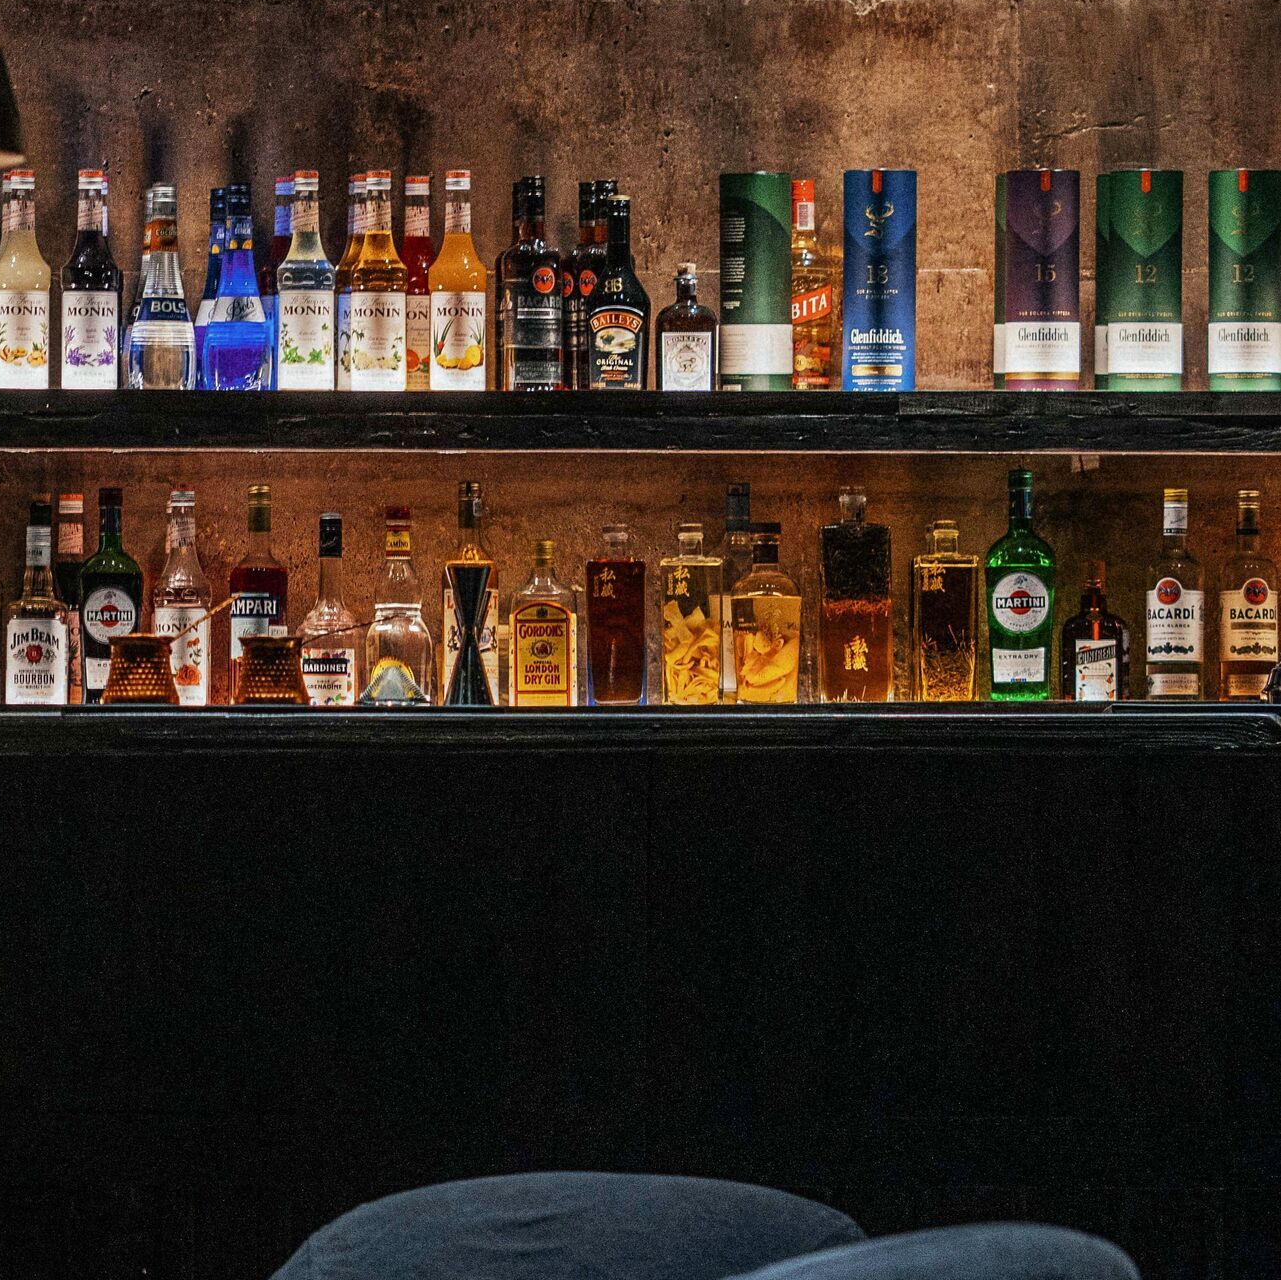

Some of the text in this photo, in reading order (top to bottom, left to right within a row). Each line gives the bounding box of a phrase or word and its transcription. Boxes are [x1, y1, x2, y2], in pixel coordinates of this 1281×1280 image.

[1033, 264, 1057, 282] 15
[1135, 264, 1158, 283] 12
[1232, 264, 1255, 283] 12
[0, 304, 46, 316] MONIN
[67, 304, 114, 317] MONIN
[150, 300, 186, 314] BOLS
[283, 304, 330, 316] MONIN
[353, 306, 400, 318] MONIN
[436, 305, 483, 317] MONIN
[592, 314, 638, 329] BAILEYS
[596, 358, 634, 366] ORIGINAL
[997, 597, 1045, 608] MARTINI
[88, 611, 132, 621] MARTINI
[10, 627, 60, 650] JIM BEAM
[303, 664, 347, 673] BARDINET
[524, 664, 560, 674] LONDON
[13, 673, 55, 685] BOURBON
[524, 674, 560, 685] DRY GIN
